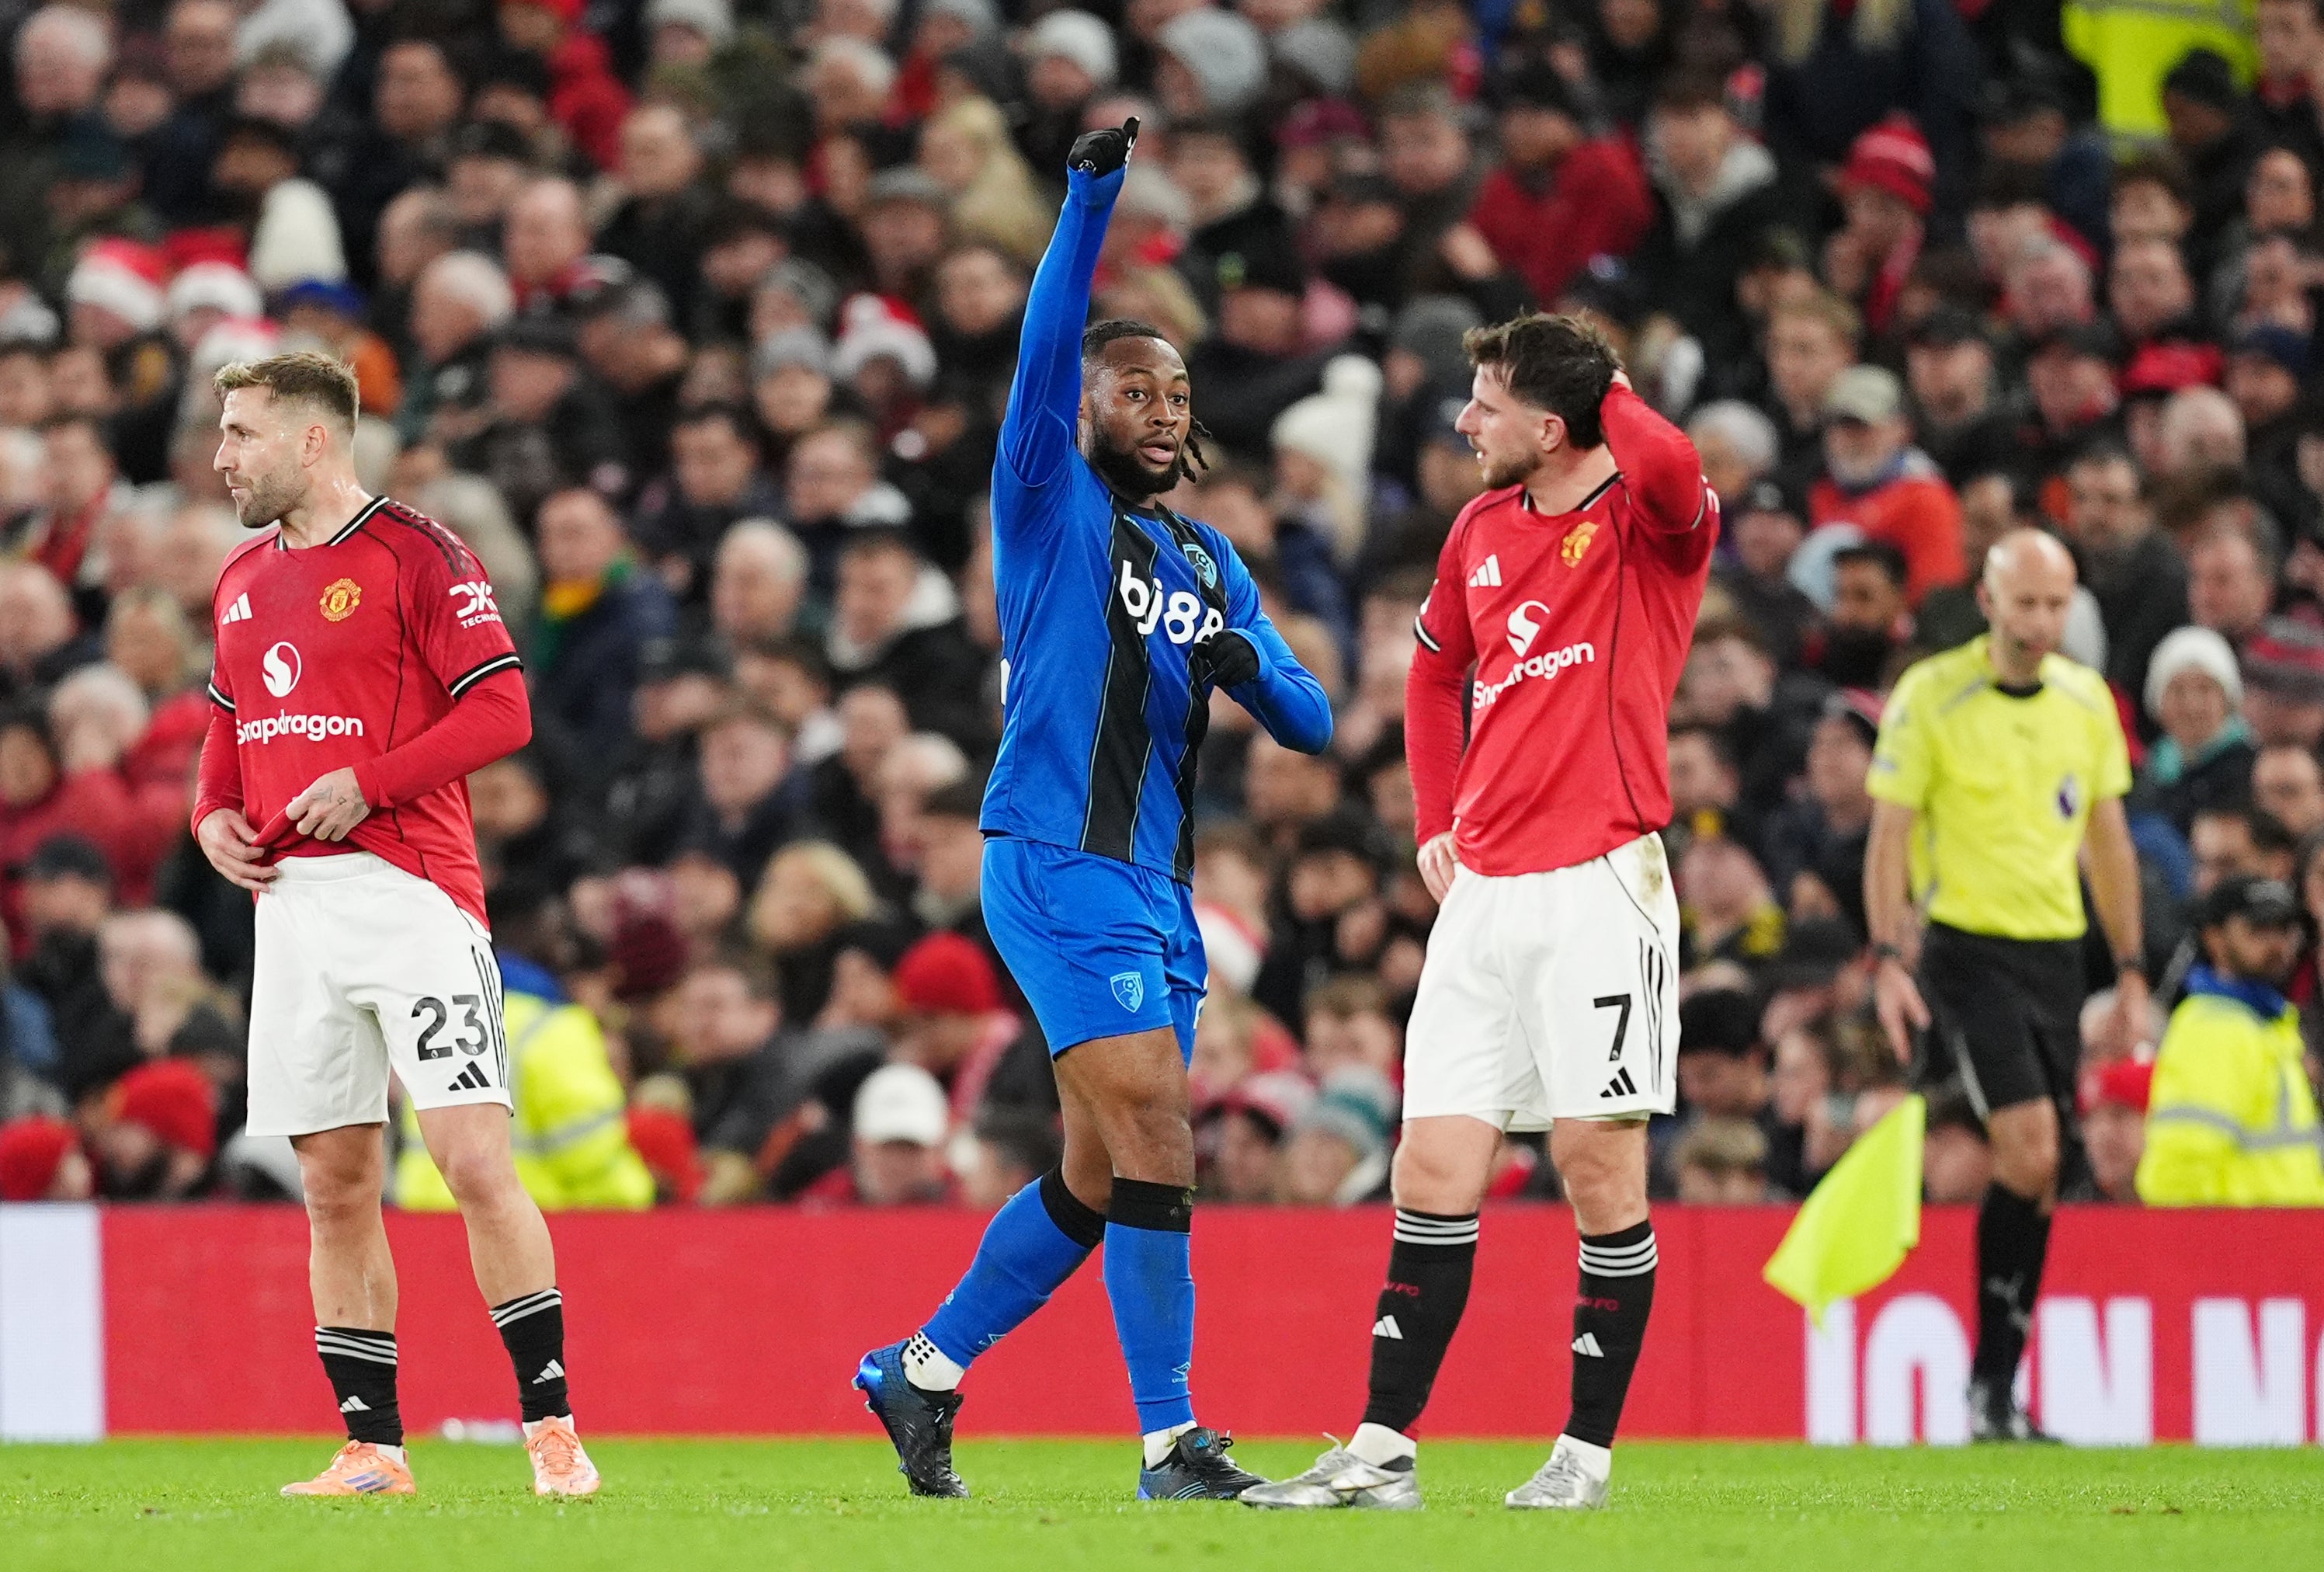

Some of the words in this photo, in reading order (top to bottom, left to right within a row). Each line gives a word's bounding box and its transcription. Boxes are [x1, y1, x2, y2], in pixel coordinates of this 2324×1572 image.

[235, 708, 363, 746] Snapdragon
[411, 994, 489, 1062] 23
[1593, 993, 1631, 1062] 7
